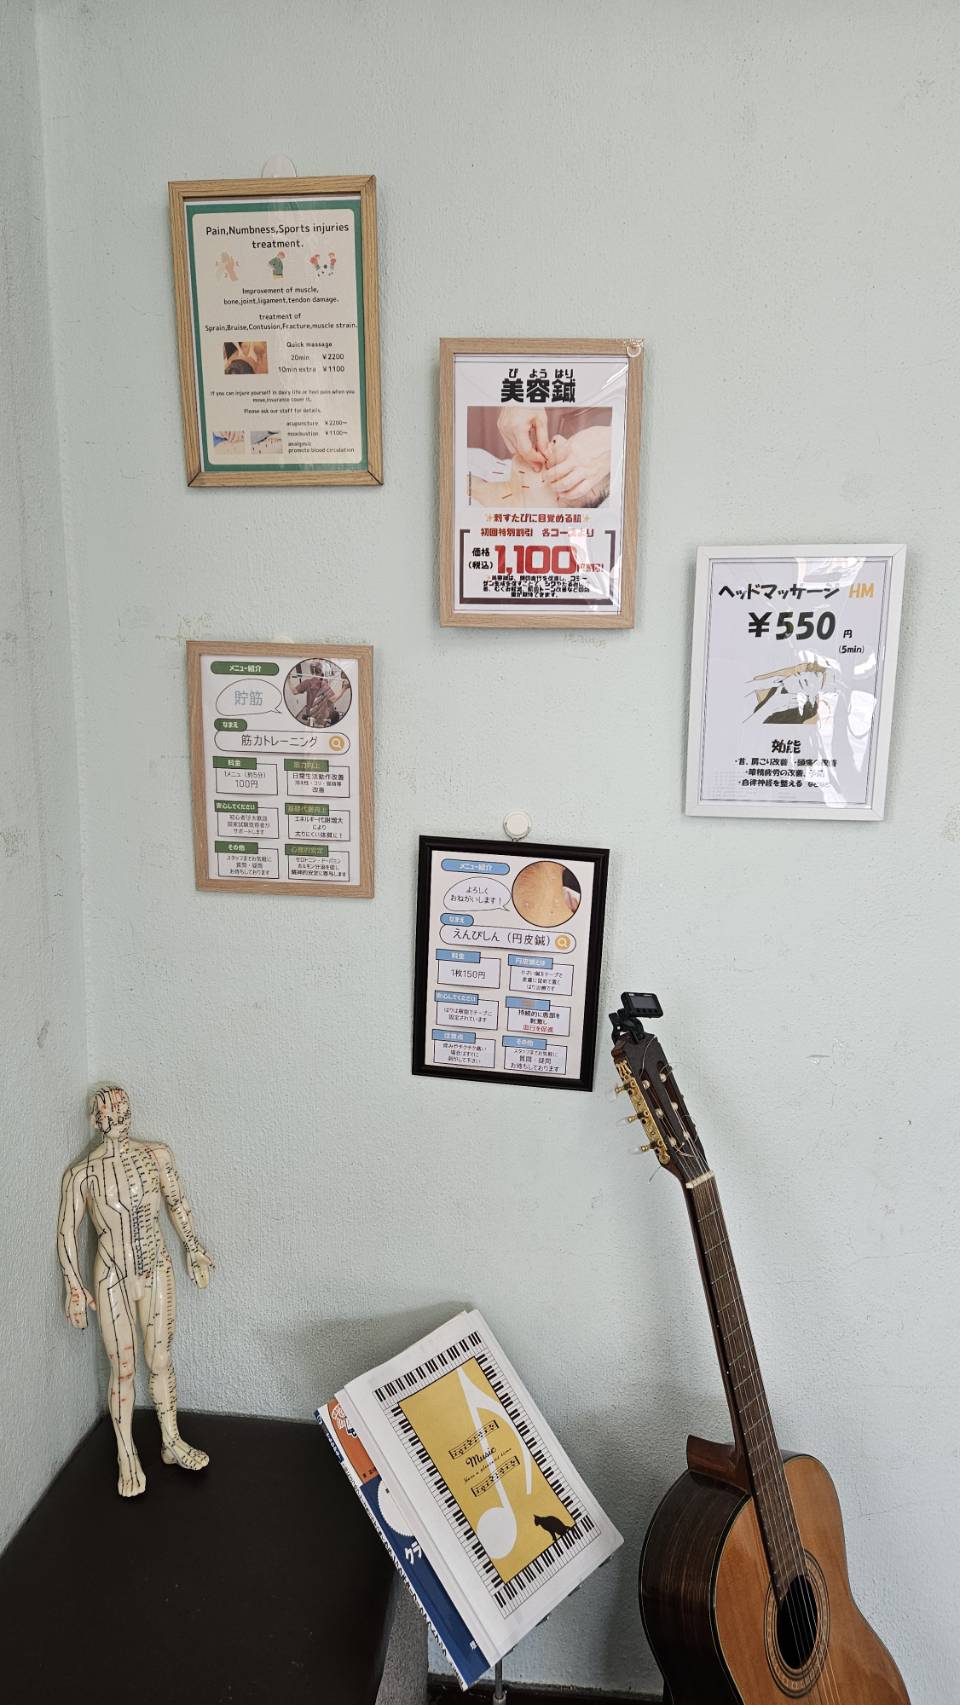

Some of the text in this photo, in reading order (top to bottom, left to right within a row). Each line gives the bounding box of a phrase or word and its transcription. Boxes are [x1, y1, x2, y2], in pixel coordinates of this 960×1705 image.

[313, 223, 349, 234] injuries
[252, 239, 304, 249] treatment.
[242, 287, 283, 295] Improvement
[295, 286, 319, 294] muscle,
[555, 369, 574, 378] はり
[501, 378, 576, 403] 美容鍼
[481, 528, 533, 537] 初回特別割引
[472, 548, 490, 557] 価格
[718, 582, 875, 600] ヘッドマッサージ HM
[843, 629, 853, 639] 円
[234, 690, 264, 706] 貯筋
[241, 734, 318, 748] 筋力トレーニング
[771, 739, 801, 754] 効能
[235, 780, 259, 789] 100円
[466, 886, 488, 895] よろしく
[451, 969, 486, 980] 1枚150円
[465, 1447, 496, 1468] Music
